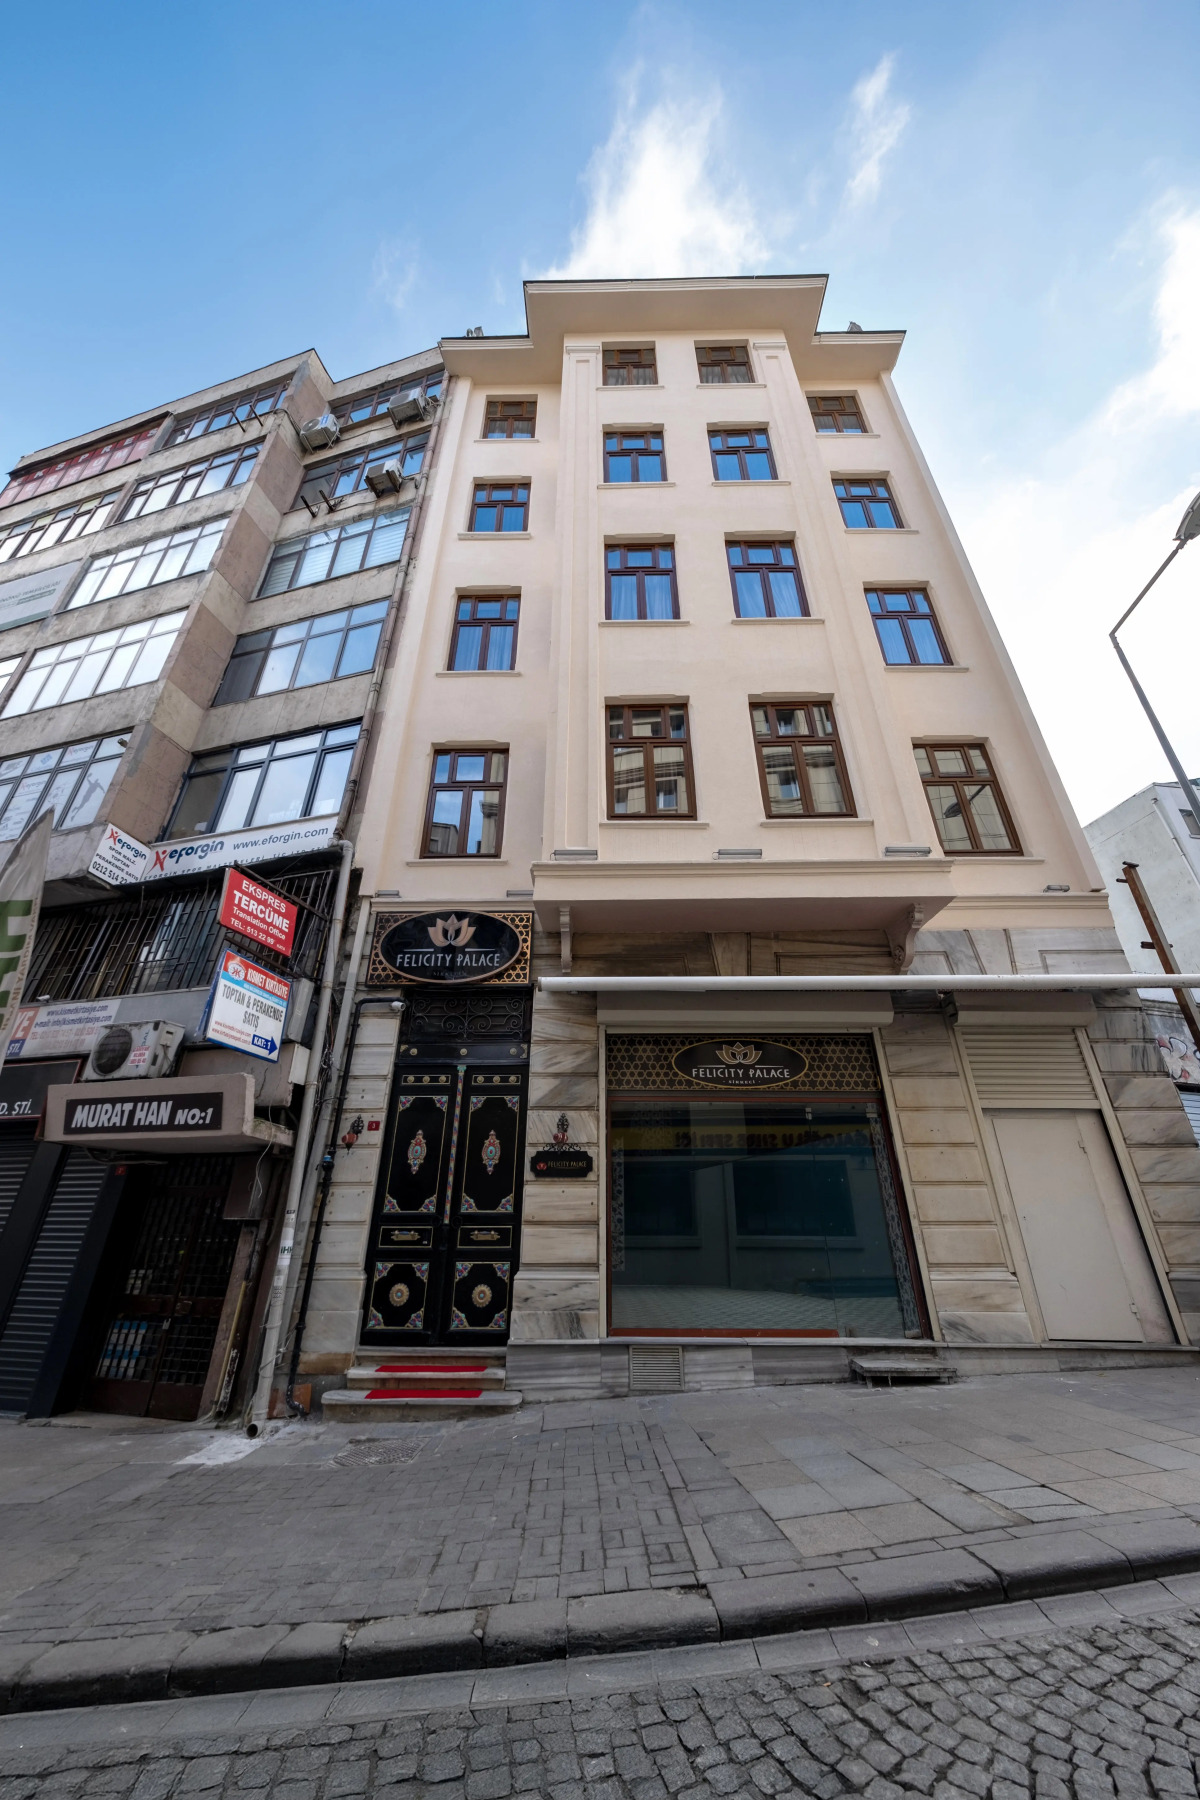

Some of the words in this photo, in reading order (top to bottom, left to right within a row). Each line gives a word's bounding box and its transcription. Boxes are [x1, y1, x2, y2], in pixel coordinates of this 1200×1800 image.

[117, 838, 147, 861] eforgin
[233, 827, 329, 850] www.eforgin.com
[95, 853, 125, 872] PERAKENDE
[111, 854, 131, 868] TOPTAN
[168, 840, 225, 864] eforgin
[92, 861, 108, 875] 0212
[108, 870, 120, 881] 514
[242, 879, 287, 913] EKSPRES
[233, 889, 290, 933] TERCÜME
[230, 918, 246, 930] TEL:
[246, 926, 258, 936] 513
[258, 932, 266, 941] 22
[233, 907, 268, 930] Translation
[268, 926, 286, 940] Office
[396, 953, 453, 967] FELICITY
[456, 953, 501, 967] PALACE
[222, 985, 247, 1006] TOPTAN
[246, 995, 252, 1008] &
[252, 998, 284, 1022] PERAKENDE
[243, 1010, 260, 1032] SATIŞ
[253, 1035, 267, 1047] KAT:
[267, 1041, 272, 1049] 1
[692, 1068, 744, 1078] FELICITY
[749, 1068, 791, 1078] PALACE
[12, 1099, 33, 1117] ŞTİ.
[71, 1102, 133, 1128] MURAT
[133, 1100, 173, 1126] HAN
[174, 1107, 213, 1125] NO:1
[547, 1160, 570, 1168] FELICITY
[570, 1160, 587, 1168] PALACE
